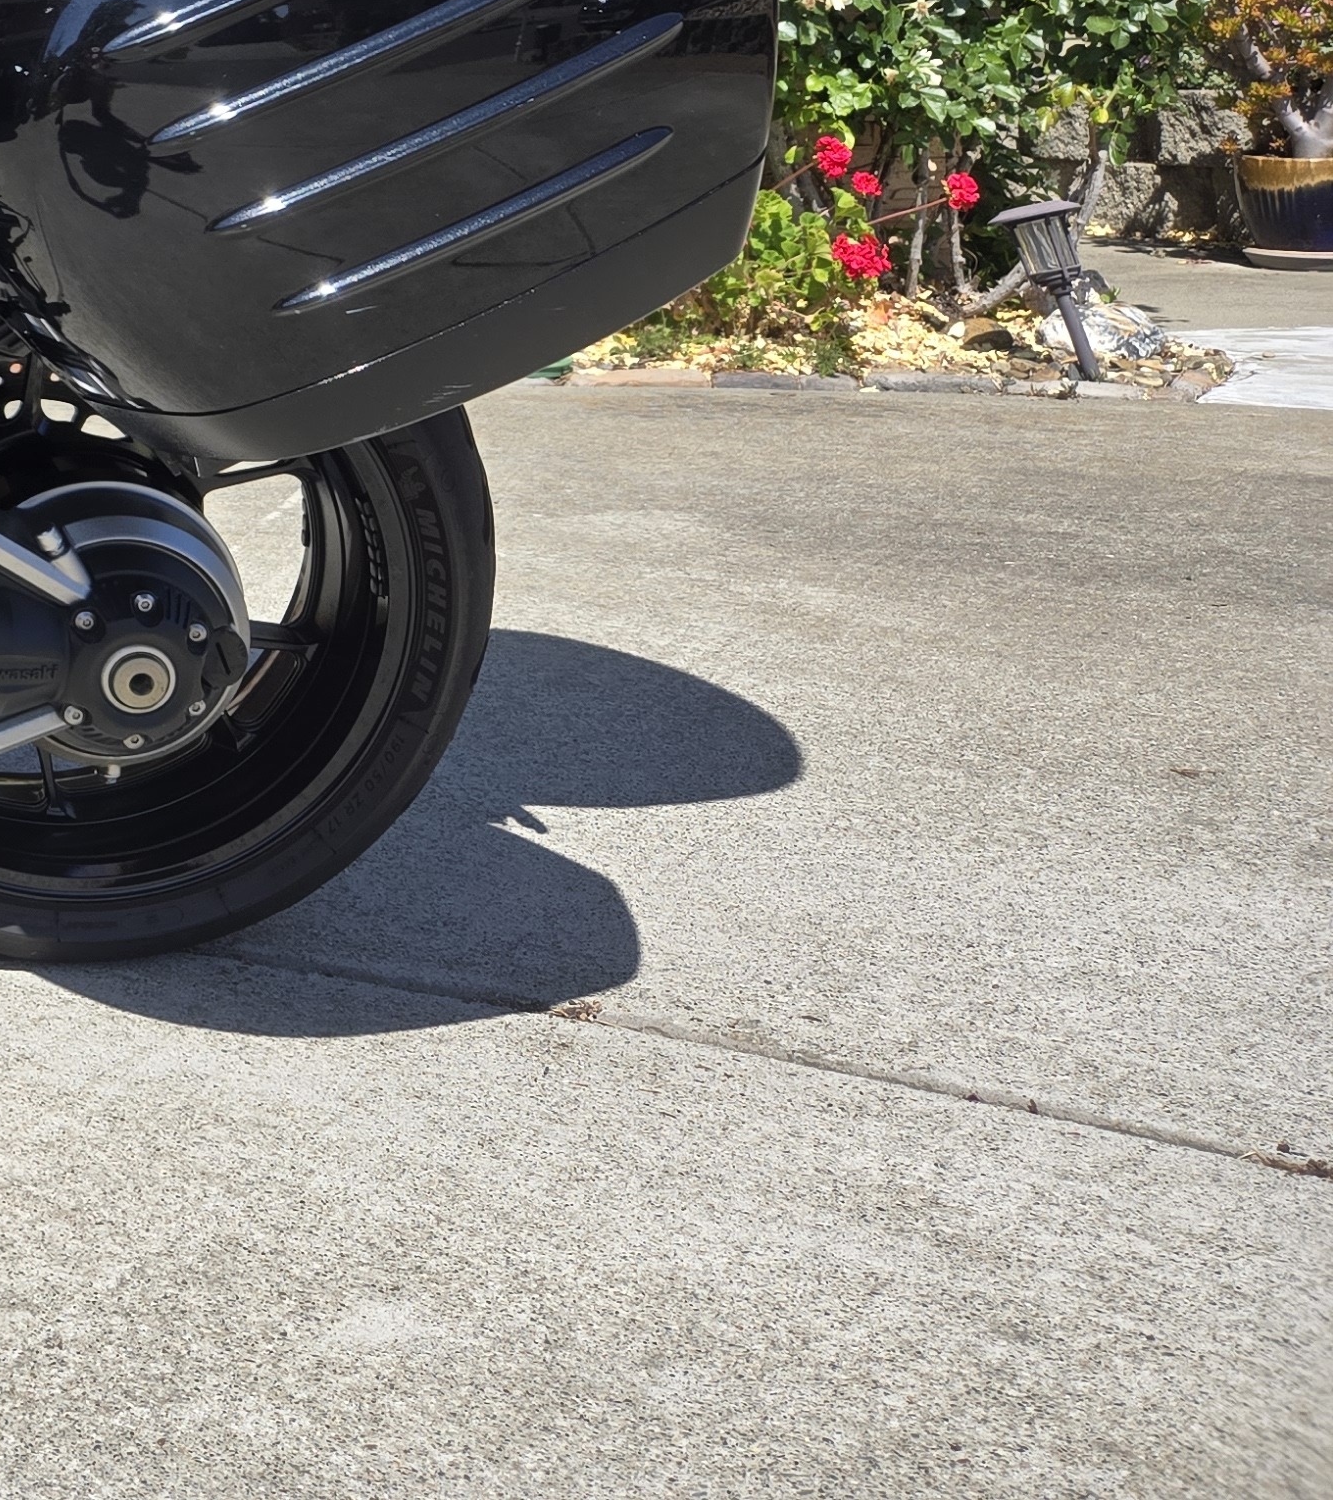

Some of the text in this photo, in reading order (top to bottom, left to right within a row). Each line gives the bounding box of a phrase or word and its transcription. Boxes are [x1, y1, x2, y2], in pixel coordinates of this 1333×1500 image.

[411, 507, 447, 703] MICHELIN
[327, 733, 406, 834] 190/50 ZR 17
